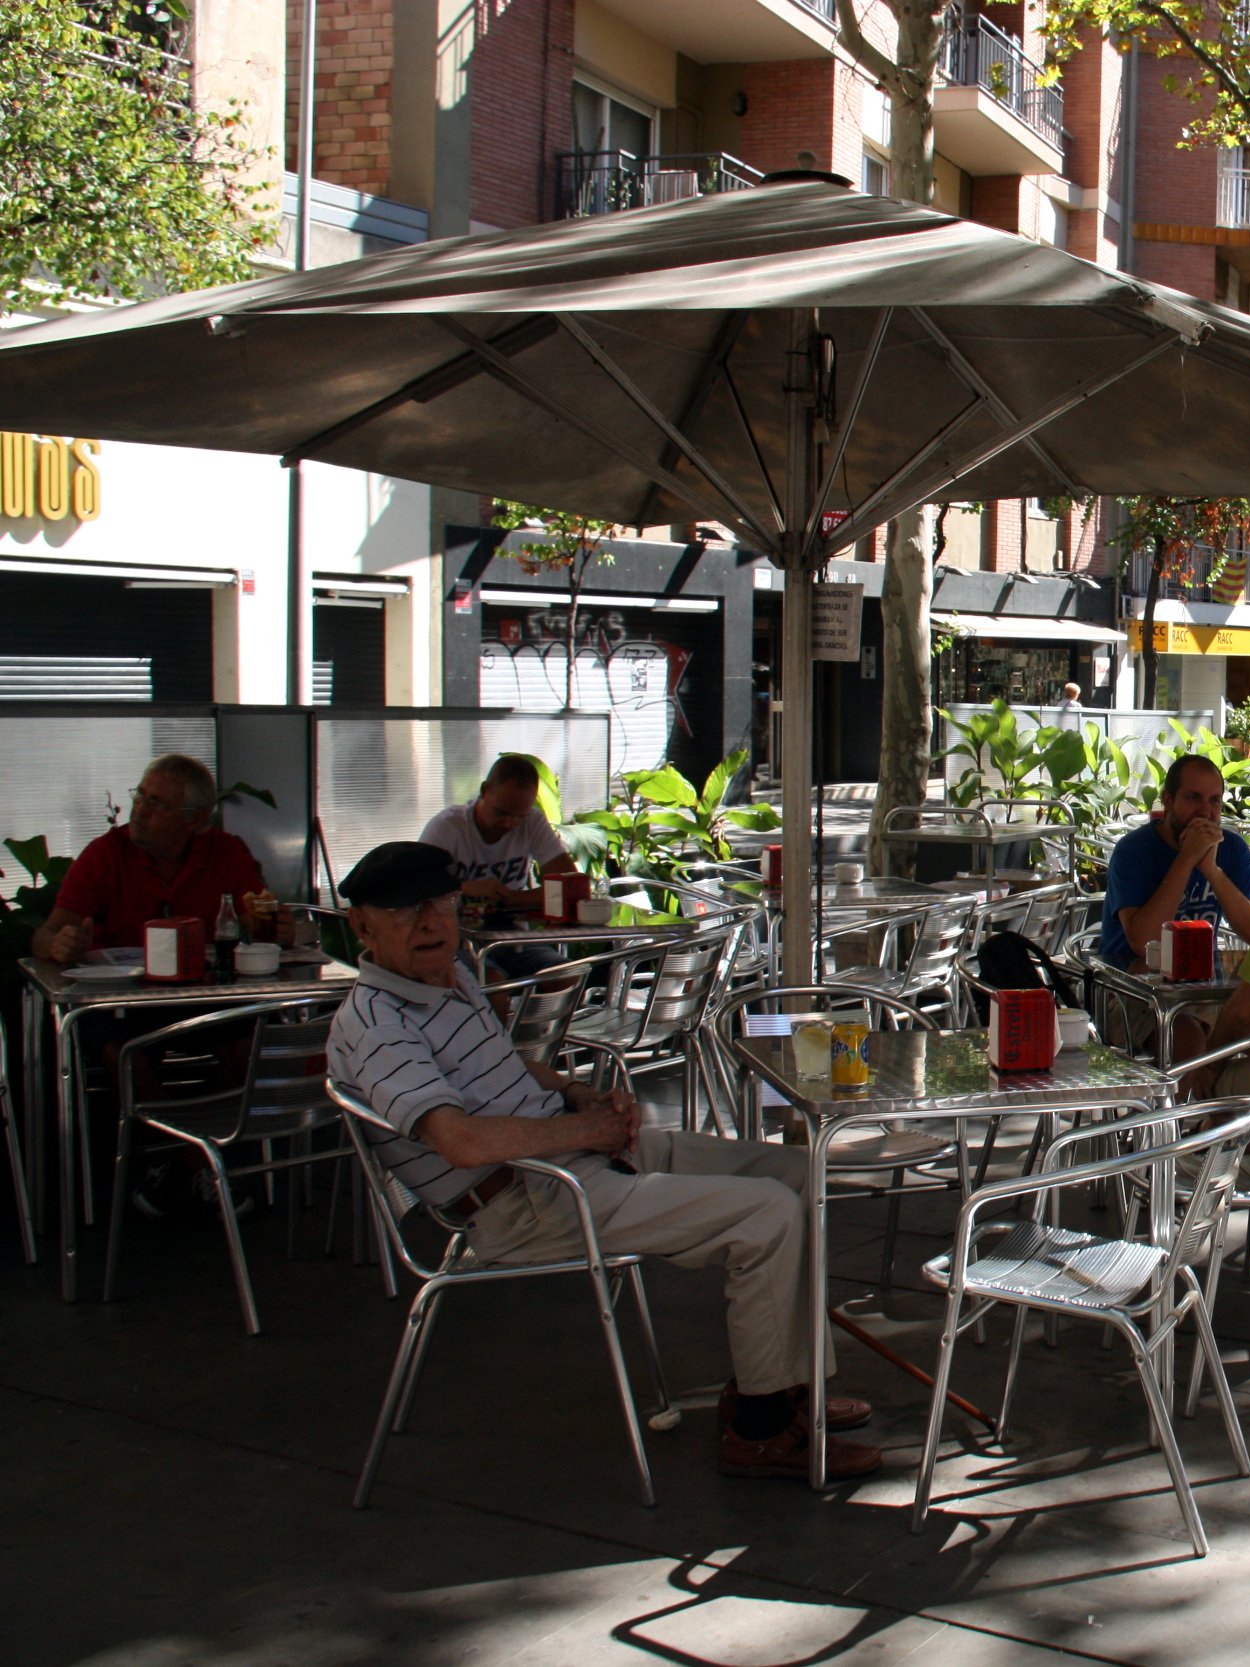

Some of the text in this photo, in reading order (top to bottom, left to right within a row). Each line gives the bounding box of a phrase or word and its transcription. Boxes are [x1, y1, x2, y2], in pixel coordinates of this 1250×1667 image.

[1172, 630, 1189, 643] RACC
[1217, 632, 1233, 645] RACC
[1005, 993, 1021, 1064] Estrella
